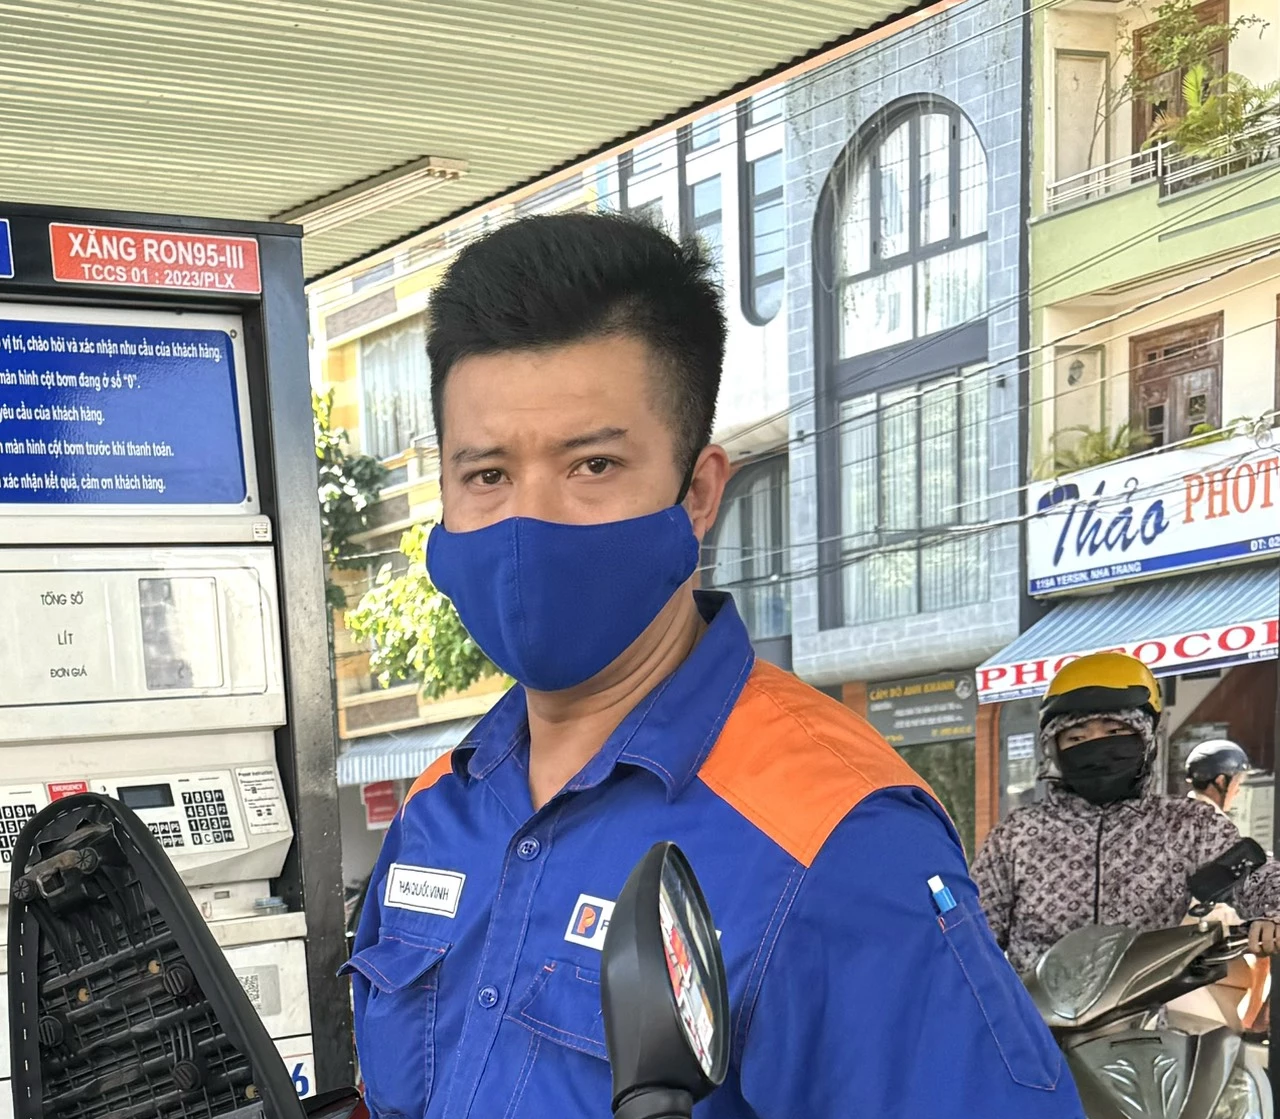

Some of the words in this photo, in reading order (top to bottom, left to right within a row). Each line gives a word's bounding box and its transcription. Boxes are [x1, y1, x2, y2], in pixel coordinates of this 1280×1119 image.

[68, 229, 136, 261] XĂNG
[143, 238, 244, 269] RON95-III
[81, 263, 127, 281] TCCS
[131, 267, 149, 283] 01
[155, 272, 160, 284] :
[163, 269, 235, 289] 2023/PLX
[2, 335, 12, 353] vị
[27, 335, 49, 352] chào
[50, 337, 65, 352] hỏi
[67, 338, 78, 352] và
[79, 337, 95, 353] xác
[96, 339, 118, 358] nhận
[120, 342, 136, 355] nhu
[138, 337, 154, 356] cầu
[155, 342, 170, 357] của
[171, 342, 198, 358] khách
[199, 343, 222, 362] hàng.
[19, 369, 37, 386] hình
[40, 372, 55, 389] cột
[56, 372, 77, 387] bơm
[79, 373, 101, 391] đang
[103, 374, 110, 388] ở
[111, 370, 122, 389] số
[16, 401, 32, 420] cầu
[34, 404, 51, 420] của
[52, 405, 79, 421] khách
[80, 406, 105, 425] hàng.
[5, 438, 25, 454] màn
[26, 439, 46, 454] hình
[48, 441, 62, 458] cột
[63, 441, 84, 455] bơm
[85, 441, 111, 456] trước
[112, 442, 125, 456] khi
[126, 442, 151, 457] thanh
[153, 442, 174, 457] toán.
[3, 473, 20, 489] xác
[21, 473, 42, 492] nhận
[45, 471, 59, 489] kết
[81, 473, 99, 490] cảm
[101, 477, 114, 490] ơn
[115, 475, 141, 490] khách
[142, 475, 166, 493] hàng.
[1036, 476, 1169, 567] Thảo
[58, 629, 73, 645] LÍT
[50, 667, 70, 678] ĐƠN
[71, 664, 87, 677] GIÁ
[291, 1062, 310, 1097] 6
